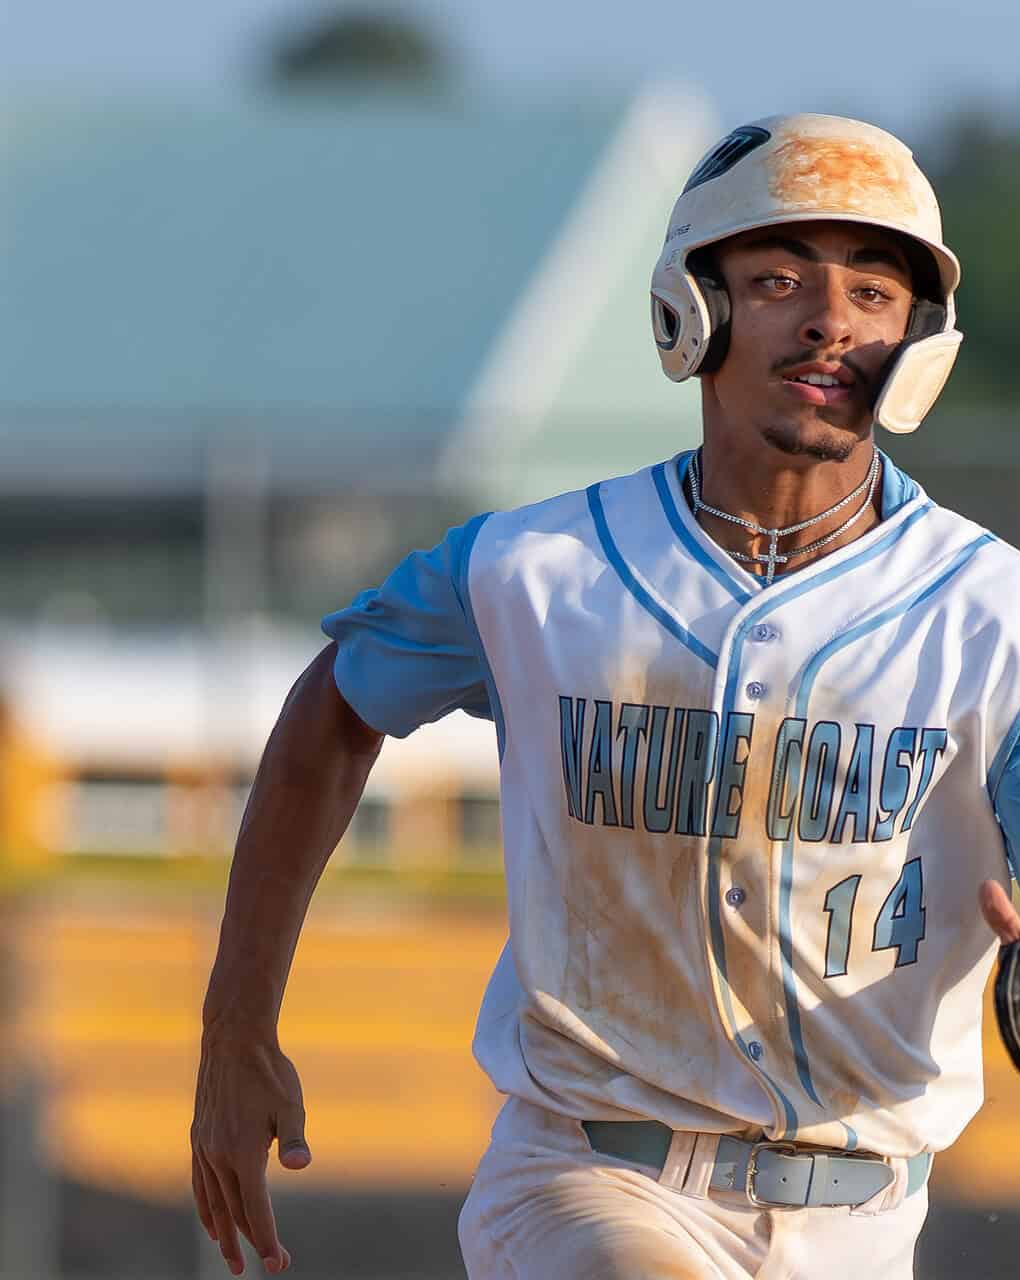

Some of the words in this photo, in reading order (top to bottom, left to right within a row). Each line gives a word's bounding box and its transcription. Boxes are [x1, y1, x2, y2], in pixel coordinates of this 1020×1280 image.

[559, 696, 755, 838] NATURE
[766, 717, 948, 844] COAST
[823, 856, 927, 979] 14
